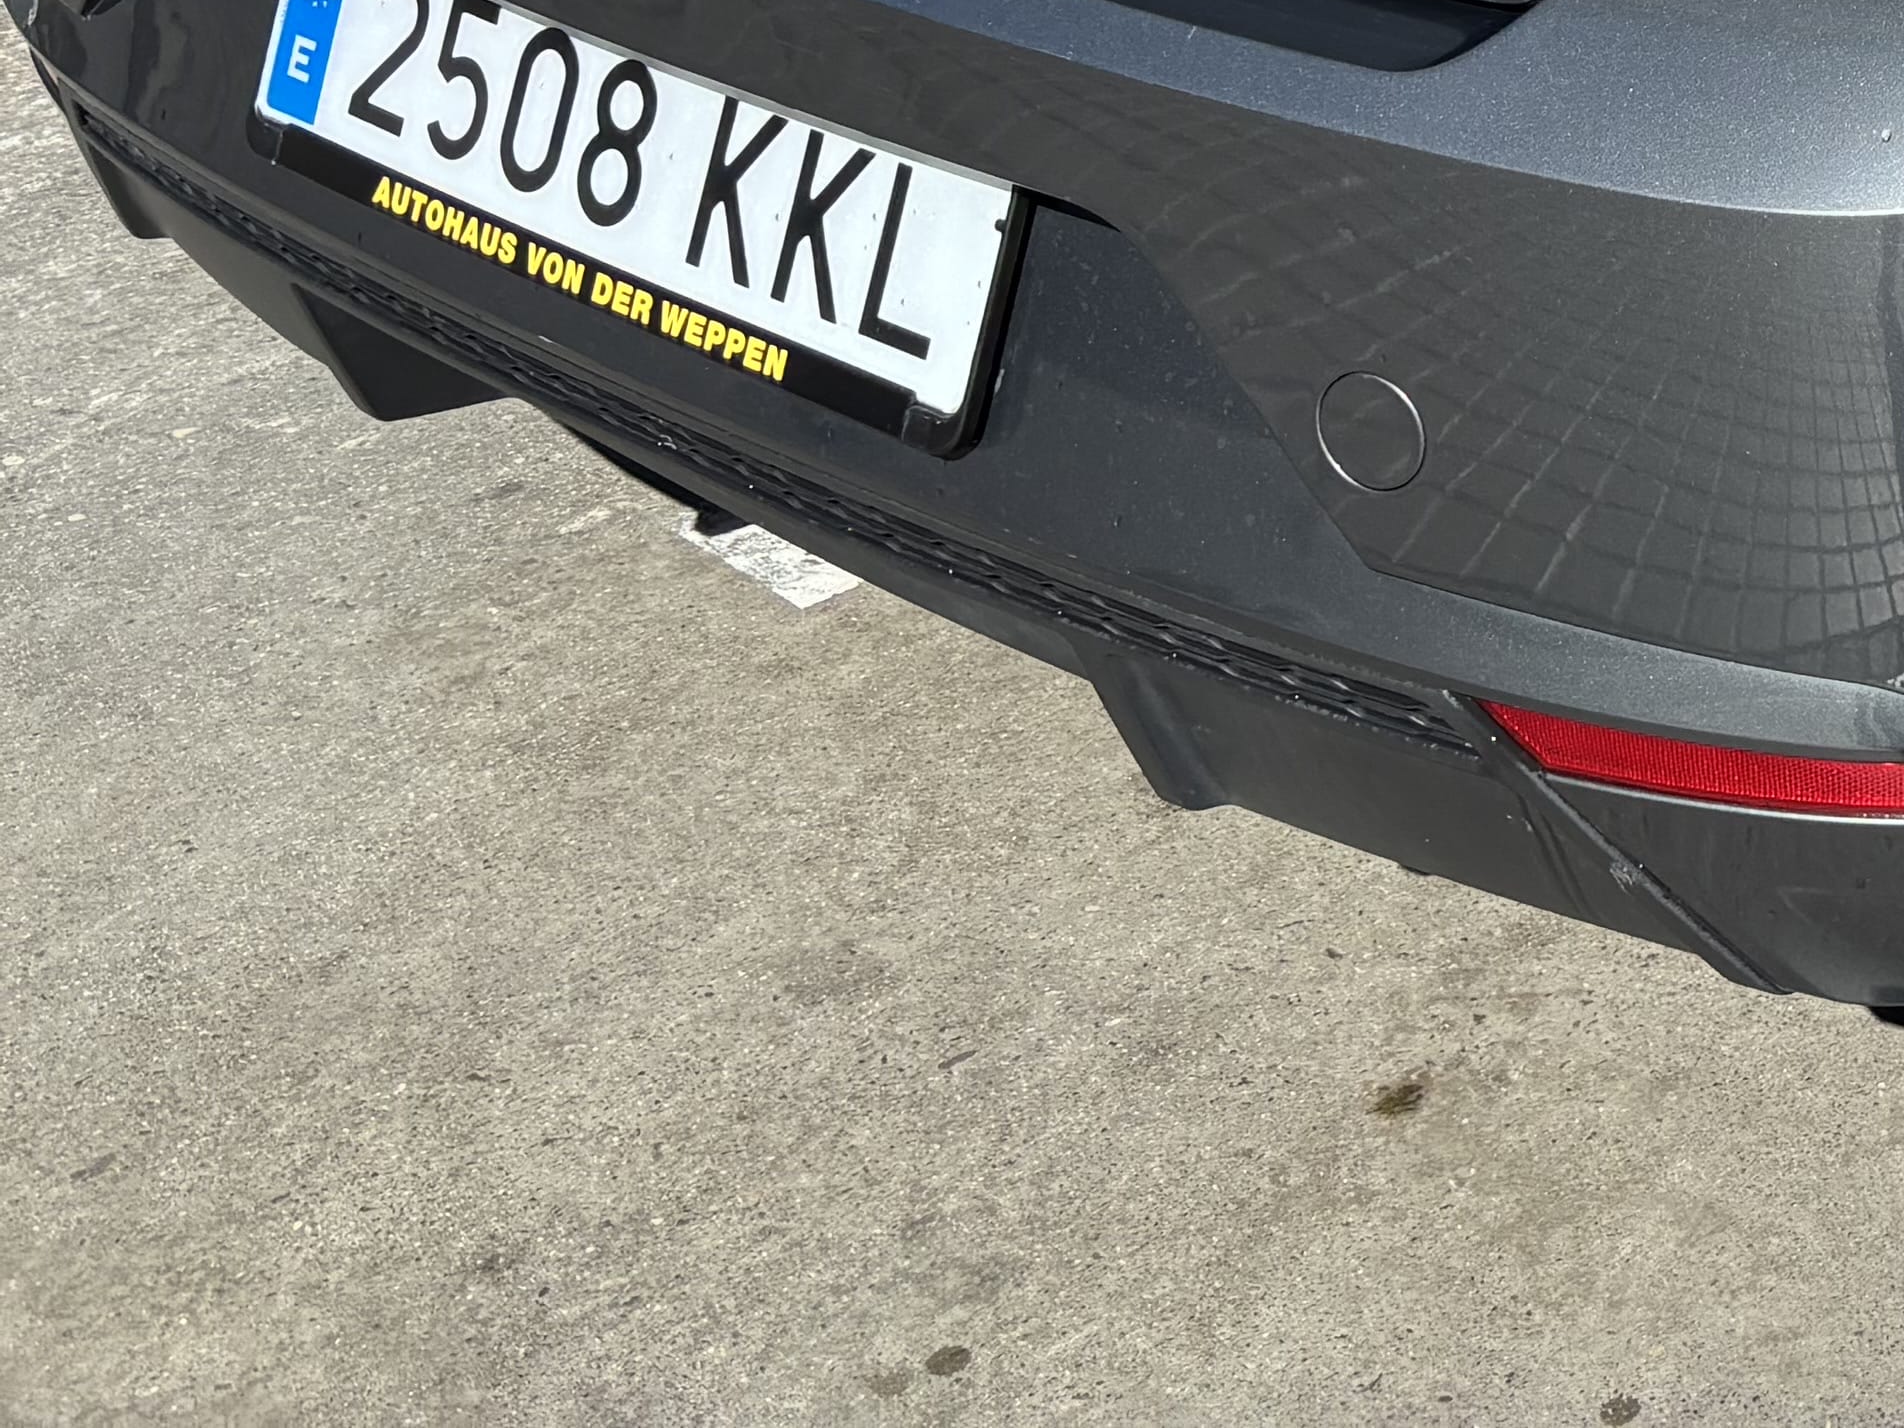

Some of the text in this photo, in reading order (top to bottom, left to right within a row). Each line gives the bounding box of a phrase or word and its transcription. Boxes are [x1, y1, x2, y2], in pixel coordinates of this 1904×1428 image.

[286, 35, 316, 83] E
[372, 176, 788, 383] AUTOHAUS VON DER WEPPEN
[685, 95, 930, 361] KKL
